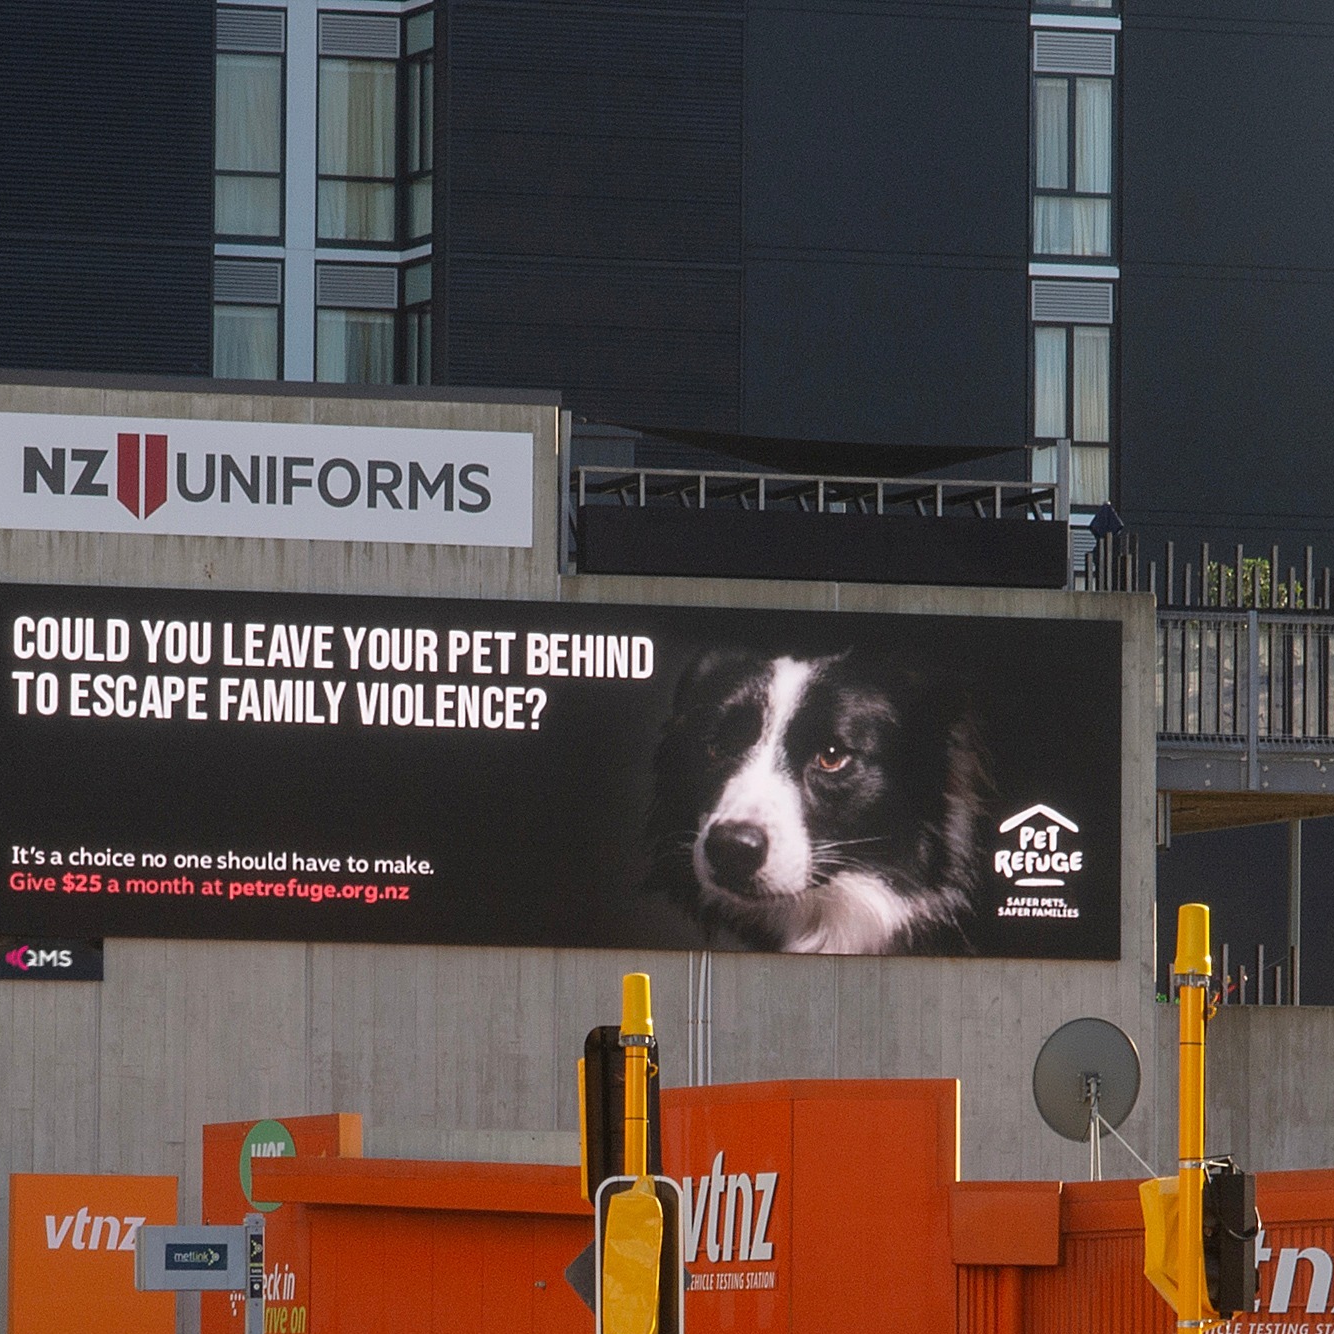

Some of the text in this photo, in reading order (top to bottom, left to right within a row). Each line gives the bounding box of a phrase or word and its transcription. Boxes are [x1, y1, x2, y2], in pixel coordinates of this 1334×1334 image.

[22, 445, 493, 513] NZ UNIFORMS
[13, 615, 655, 679] COULD YOU LEAVE YOUR PET BEHIND
[11, 671, 548, 730] TO ESCAPE FAMILY VIOLENCE?
[11, 846, 435, 875] It's a choice no one should have to make.
[994, 850, 1083, 878] REFUGE
[9, 871, 410, 903] Give $25 a month at petrefuge.org.nz
[997, 906, 1080, 918] SAFER FAMILIES
[1006, 897, 1068, 908] SAFER PETS,
[682, 1150, 778, 1263] vtnz
[45, 1206, 147, 1251] vtnz
[174, 1249, 209, 1263] metlink
[283, 1263, 295, 1300] in
[687, 1271, 776, 1291] EHICLE TESTING STATION
[264, 1306, 306, 1334] rive on
